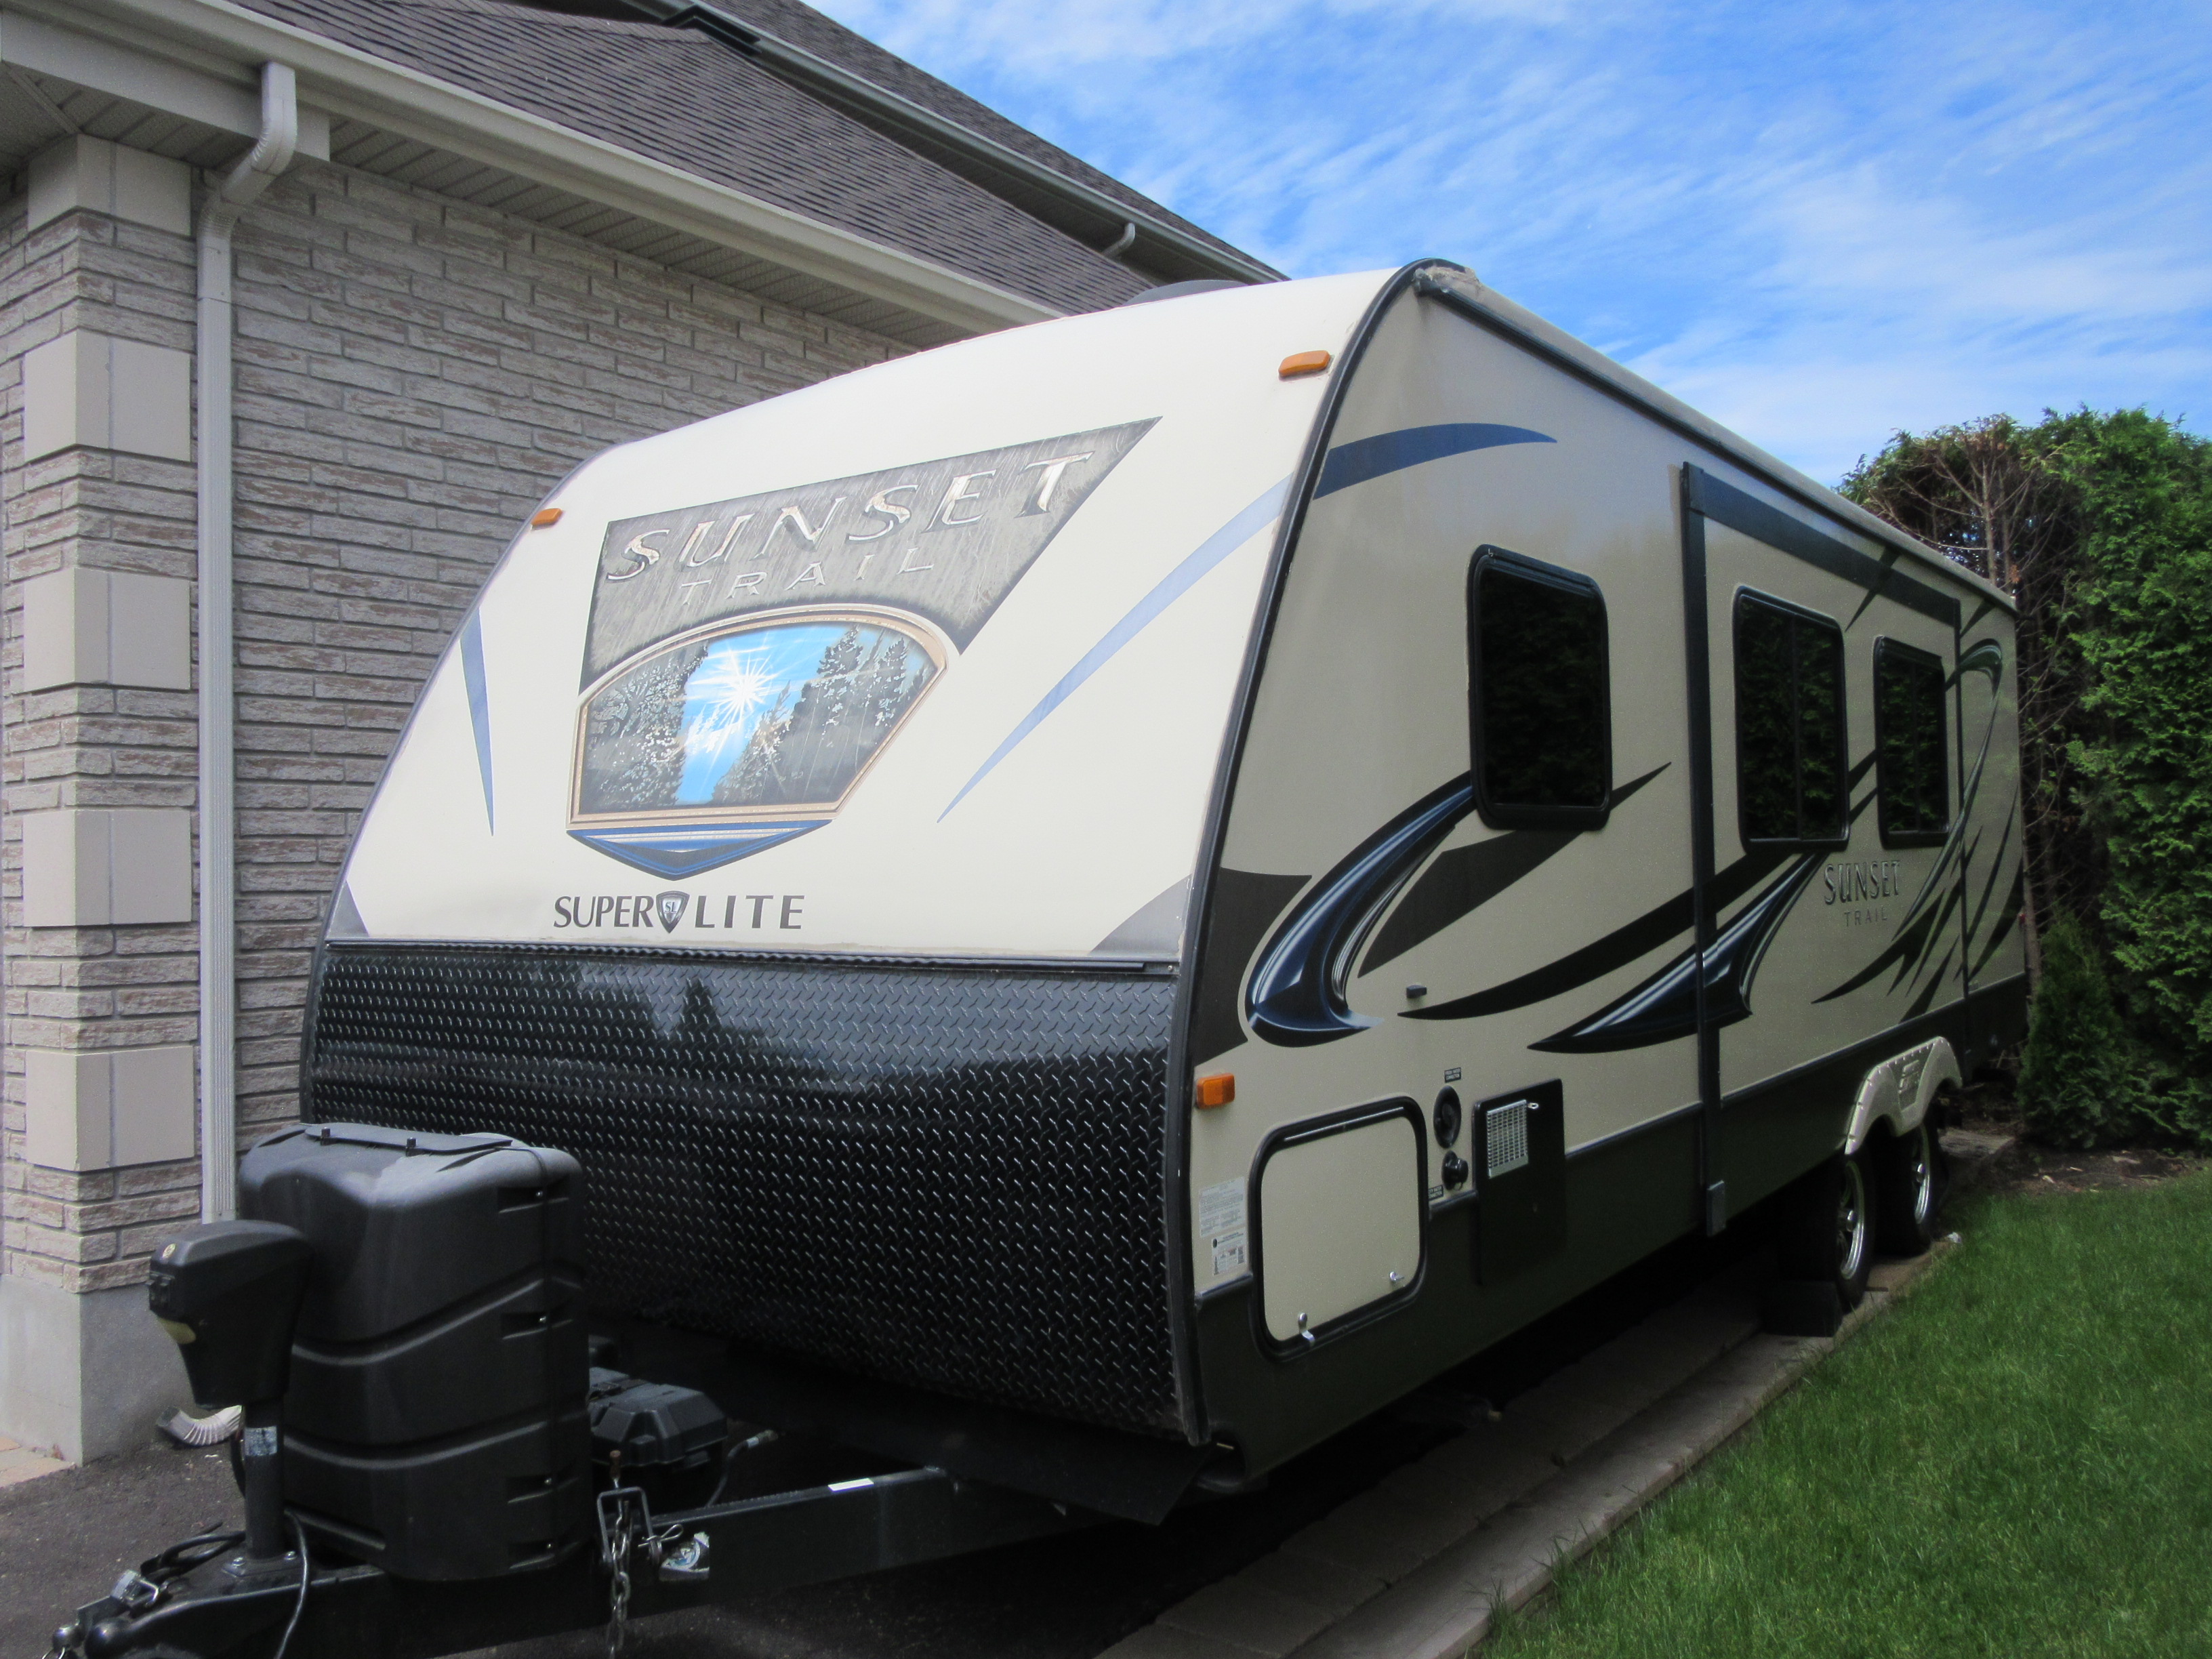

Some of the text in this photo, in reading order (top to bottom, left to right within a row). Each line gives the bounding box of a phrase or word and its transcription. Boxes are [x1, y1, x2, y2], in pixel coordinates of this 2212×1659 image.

[606, 451, 1095, 584] SUNSET
[679, 548, 935, 606] TRAIL
[1824, 860, 1900, 905] SUNSET
[553, 895, 805, 930] SUPER SL LITE
[1844, 907, 1888, 927] TRAIL
